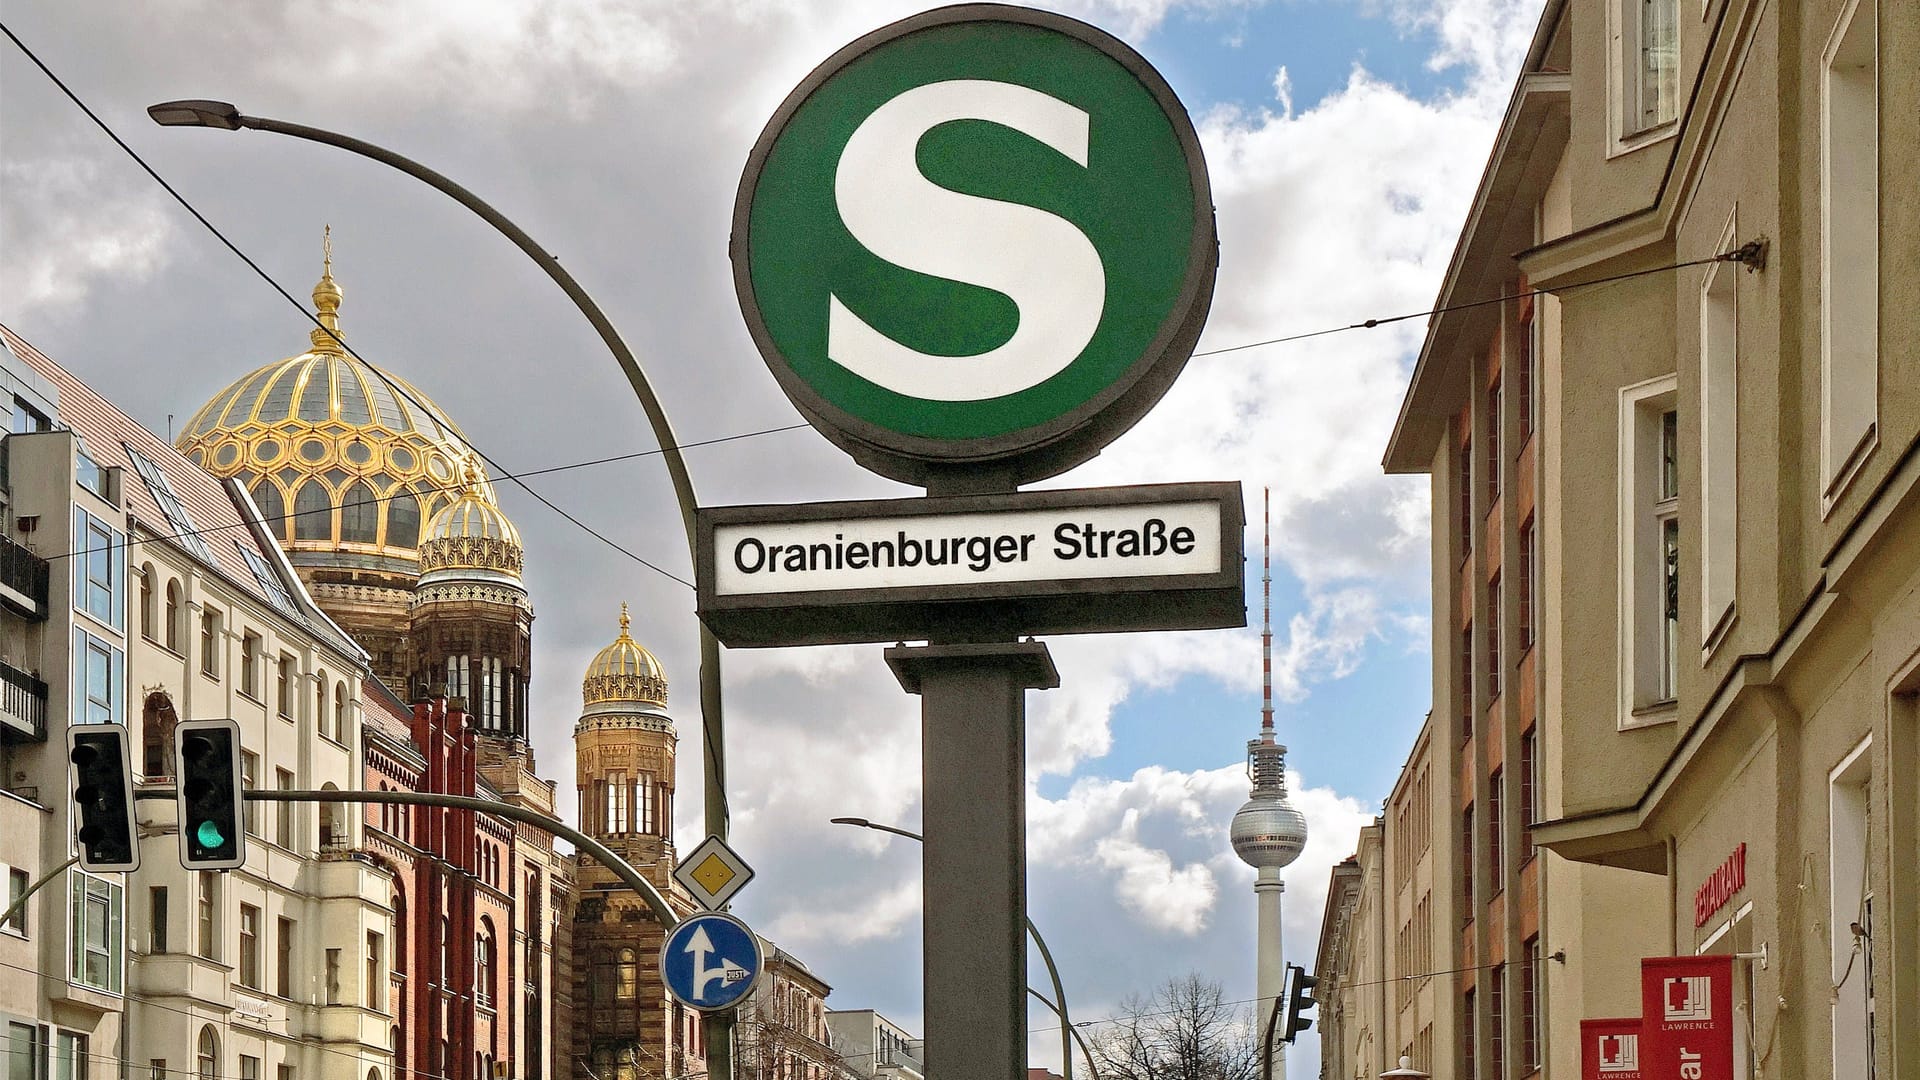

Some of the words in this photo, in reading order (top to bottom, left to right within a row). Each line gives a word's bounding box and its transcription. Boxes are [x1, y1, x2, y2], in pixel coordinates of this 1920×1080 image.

[828, 79, 1106, 402] S
[735, 532, 1035, 574] Oranienburger
[1053, 519, 1196, 561] Straße
[1695, 842, 1746, 928] RESTAURANT
[727, 970, 744, 979] JUST
[1662, 1022, 1715, 1031] LAWRENCE
[1597, 1072, 1641, 1080] LAWRENCE
